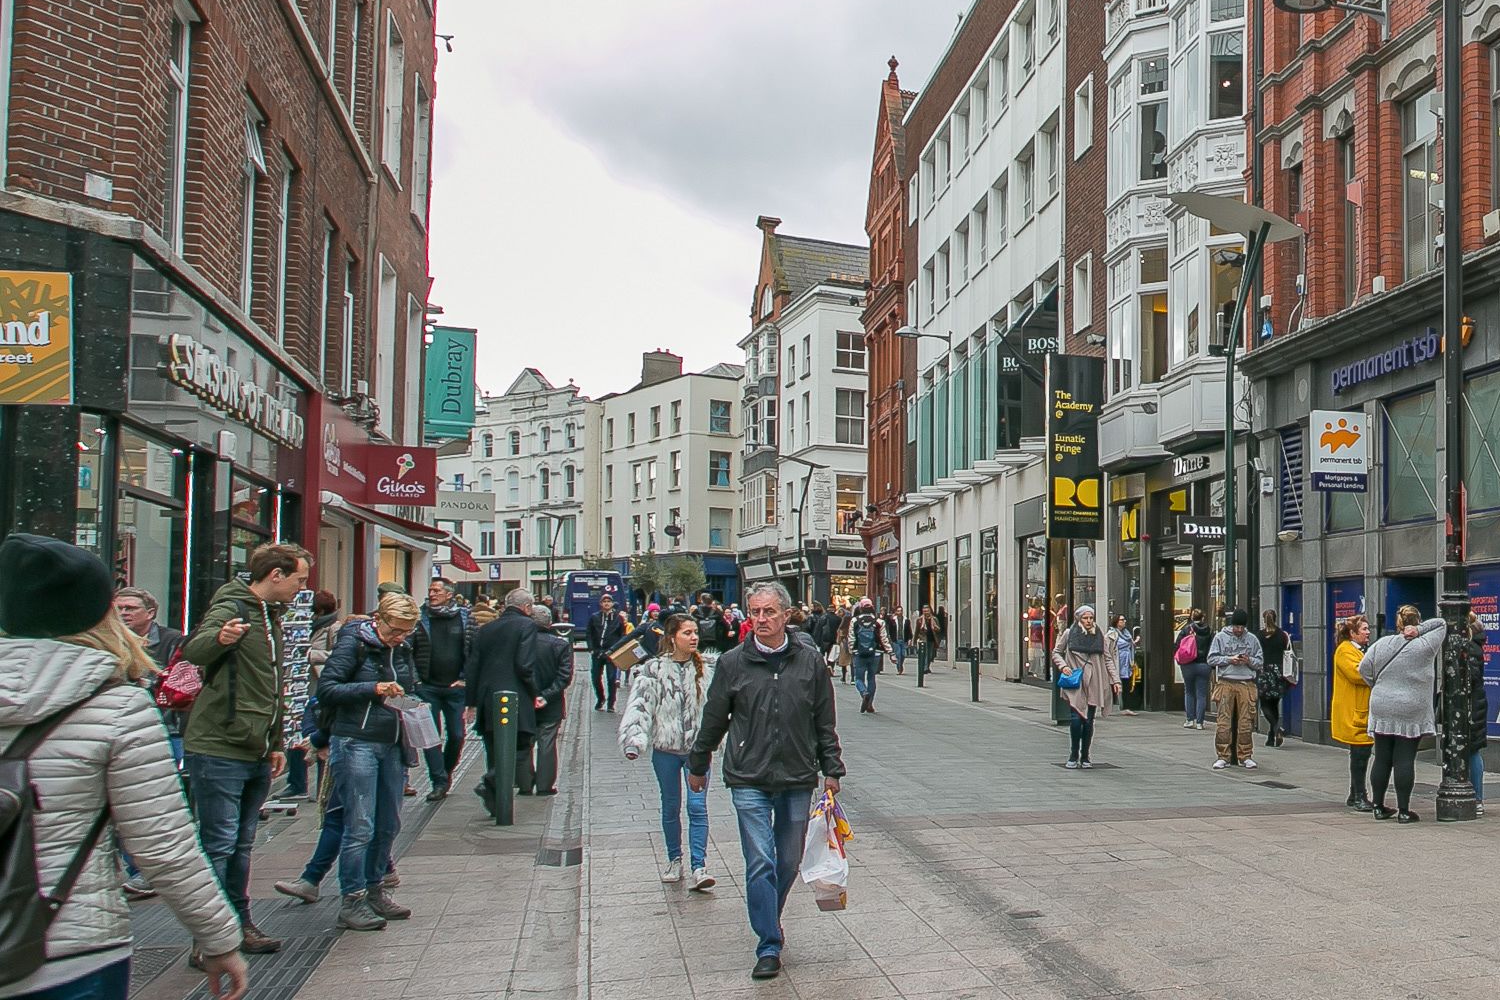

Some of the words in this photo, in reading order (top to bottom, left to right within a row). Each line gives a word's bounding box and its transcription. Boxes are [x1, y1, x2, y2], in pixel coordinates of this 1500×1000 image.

[1331, 340, 1409, 396] permanent
[1412, 327, 1440, 363] tsb
[441, 338, 469, 415] Dubray
[1055, 390, 1071, 400] The
[1055, 400, 1093, 413] Academy
[1055, 410, 1064, 419] @
[1055, 433, 1086, 444] Lunatic
[1055, 444, 1082, 455] Fringe
[1055, 453, 1064, 462] @
[1353, 456, 1363, 464] tsb
[1173, 455, 1206, 477] Dune
[1324, 474, 1352, 483] Mortgages
[377, 476, 426, 495] Gino's
[1318, 481, 1343, 489] Personal
[1343, 482, 1364, 490] Lending
[1476, 613, 1493, 622] AFTON
[1493, 613, 1500, 622] ST
